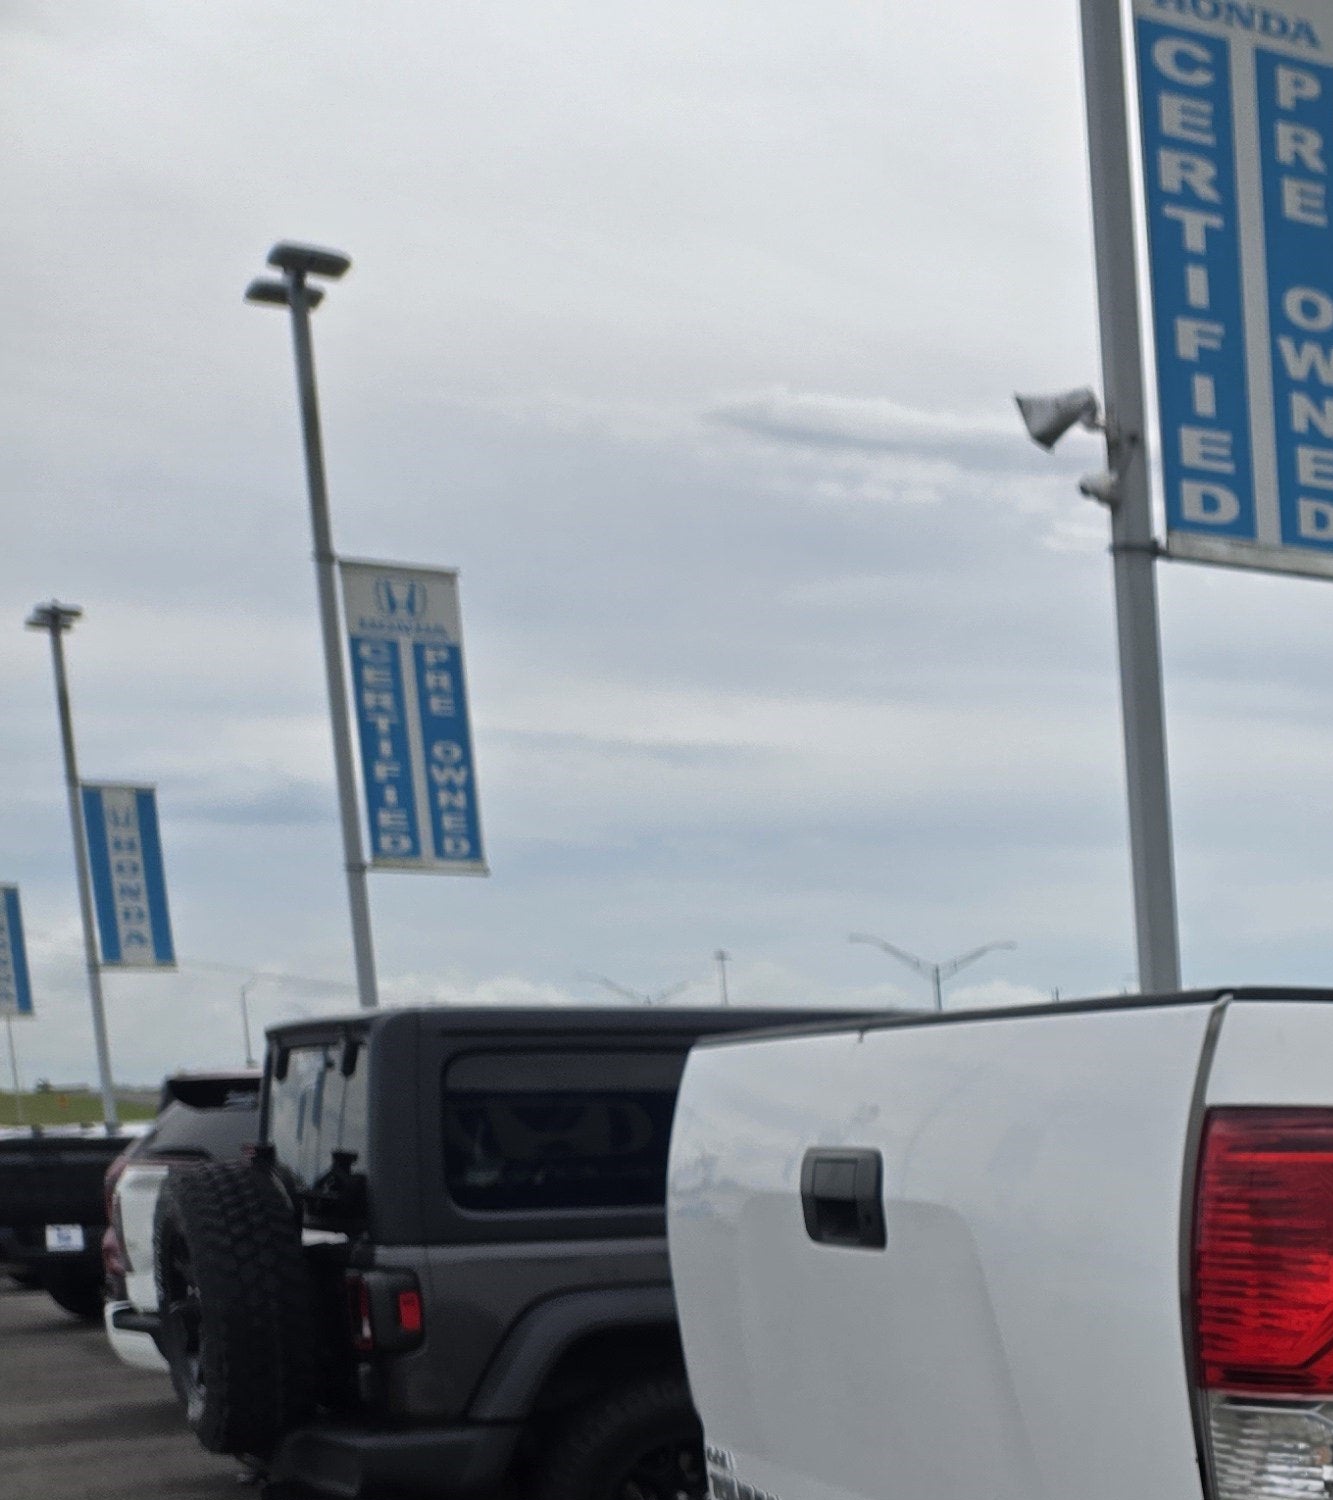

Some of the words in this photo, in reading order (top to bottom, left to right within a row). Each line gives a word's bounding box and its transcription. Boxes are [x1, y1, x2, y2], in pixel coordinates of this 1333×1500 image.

[1274, 63, 1328, 228] PRE
[1151, 35, 1241, 526] CERTIFIED
[358, 641, 412, 855] CERTIFIED
[424, 647, 456, 718] PRE
[430, 739, 472, 859] OWNED
